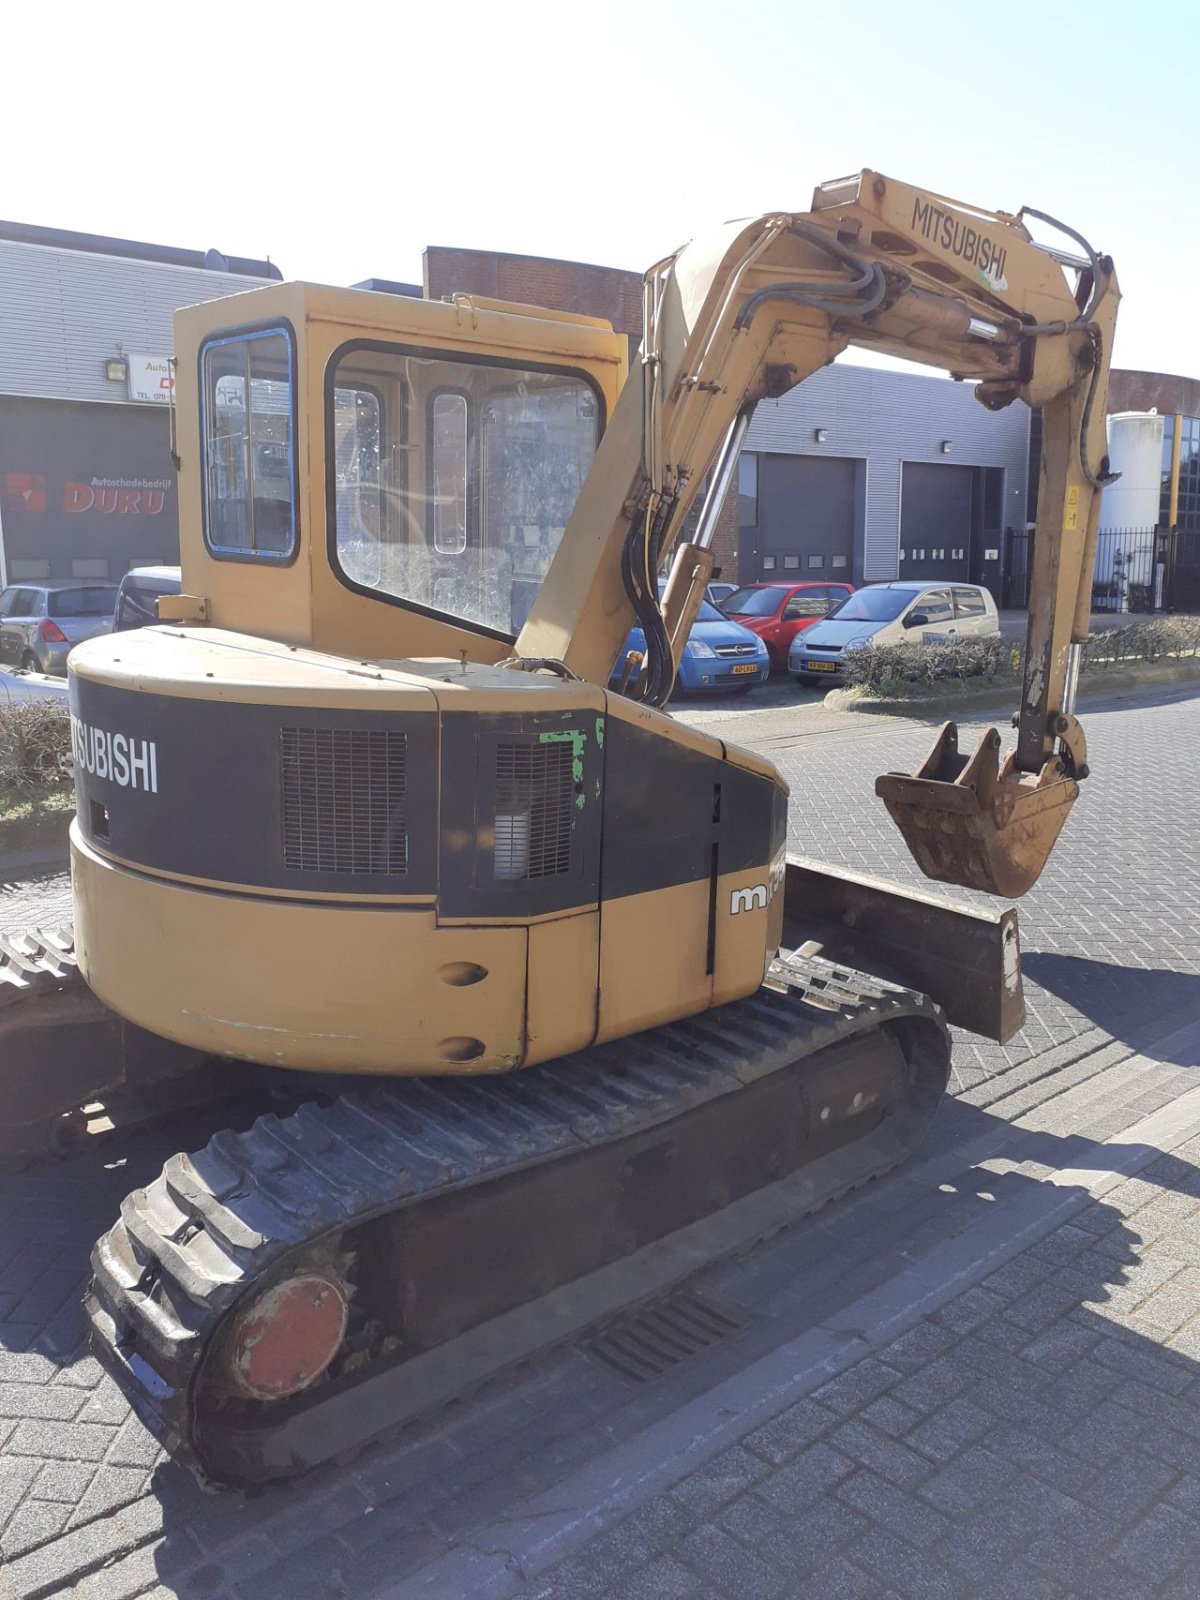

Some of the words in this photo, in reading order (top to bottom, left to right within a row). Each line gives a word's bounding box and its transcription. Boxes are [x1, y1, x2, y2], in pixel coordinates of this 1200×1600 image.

[911, 197, 1007, 281] MITSUBISHI
[65, 483, 164, 514] DURU
[91, 477, 171, 491] Autoschadebedrijf
